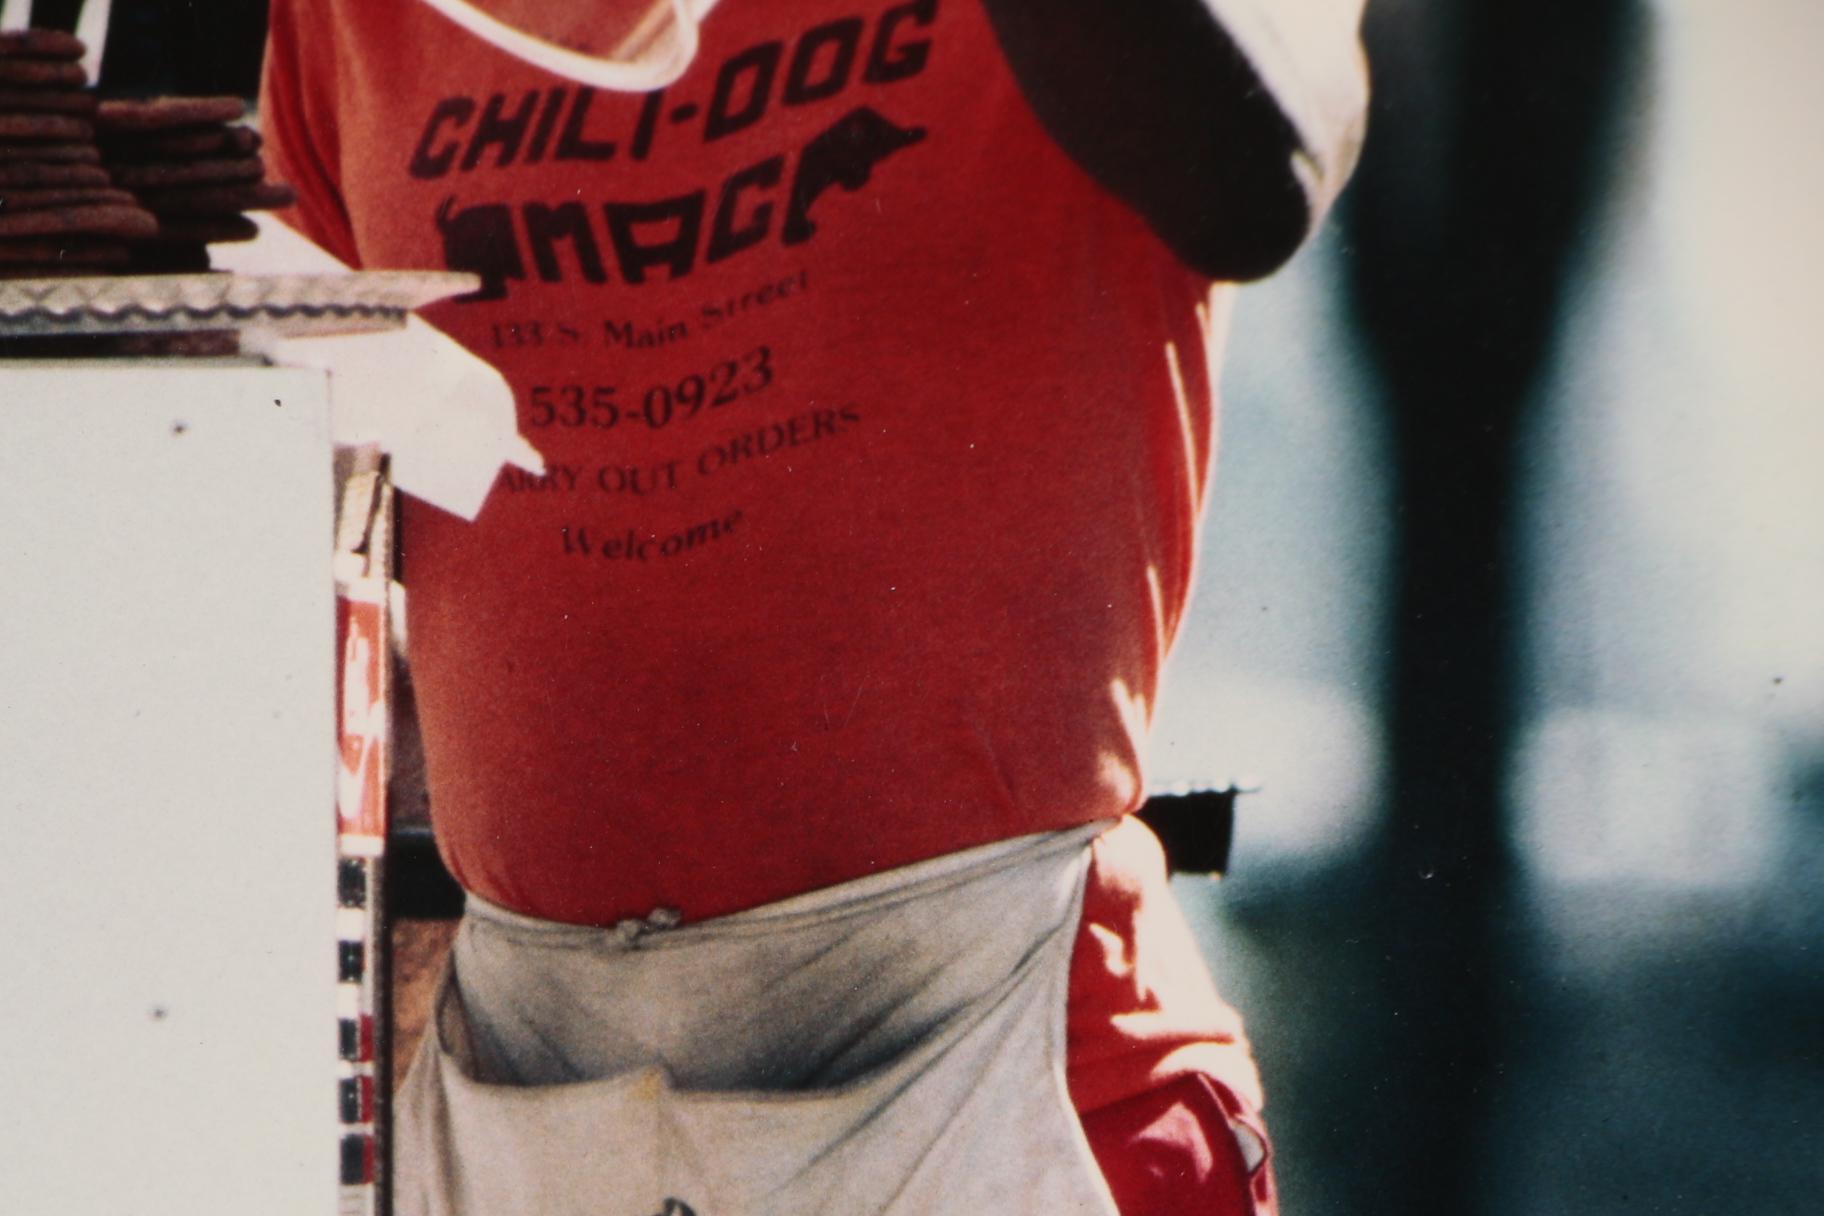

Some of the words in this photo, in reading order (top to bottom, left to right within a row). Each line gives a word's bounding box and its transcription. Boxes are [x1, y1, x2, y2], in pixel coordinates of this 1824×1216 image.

[408, 0, 936, 180] CHILI-DOG
[603, 319, 689, 349] Main
[701, 268, 810, 328] Street
[530, 345, 776, 430] 535-0923
[499, 463, 584, 493] ARRY
[597, 460, 682, 496] OUT
[695, 405, 862, 476] ORDERS
[559, 507, 744, 563] Welcome
